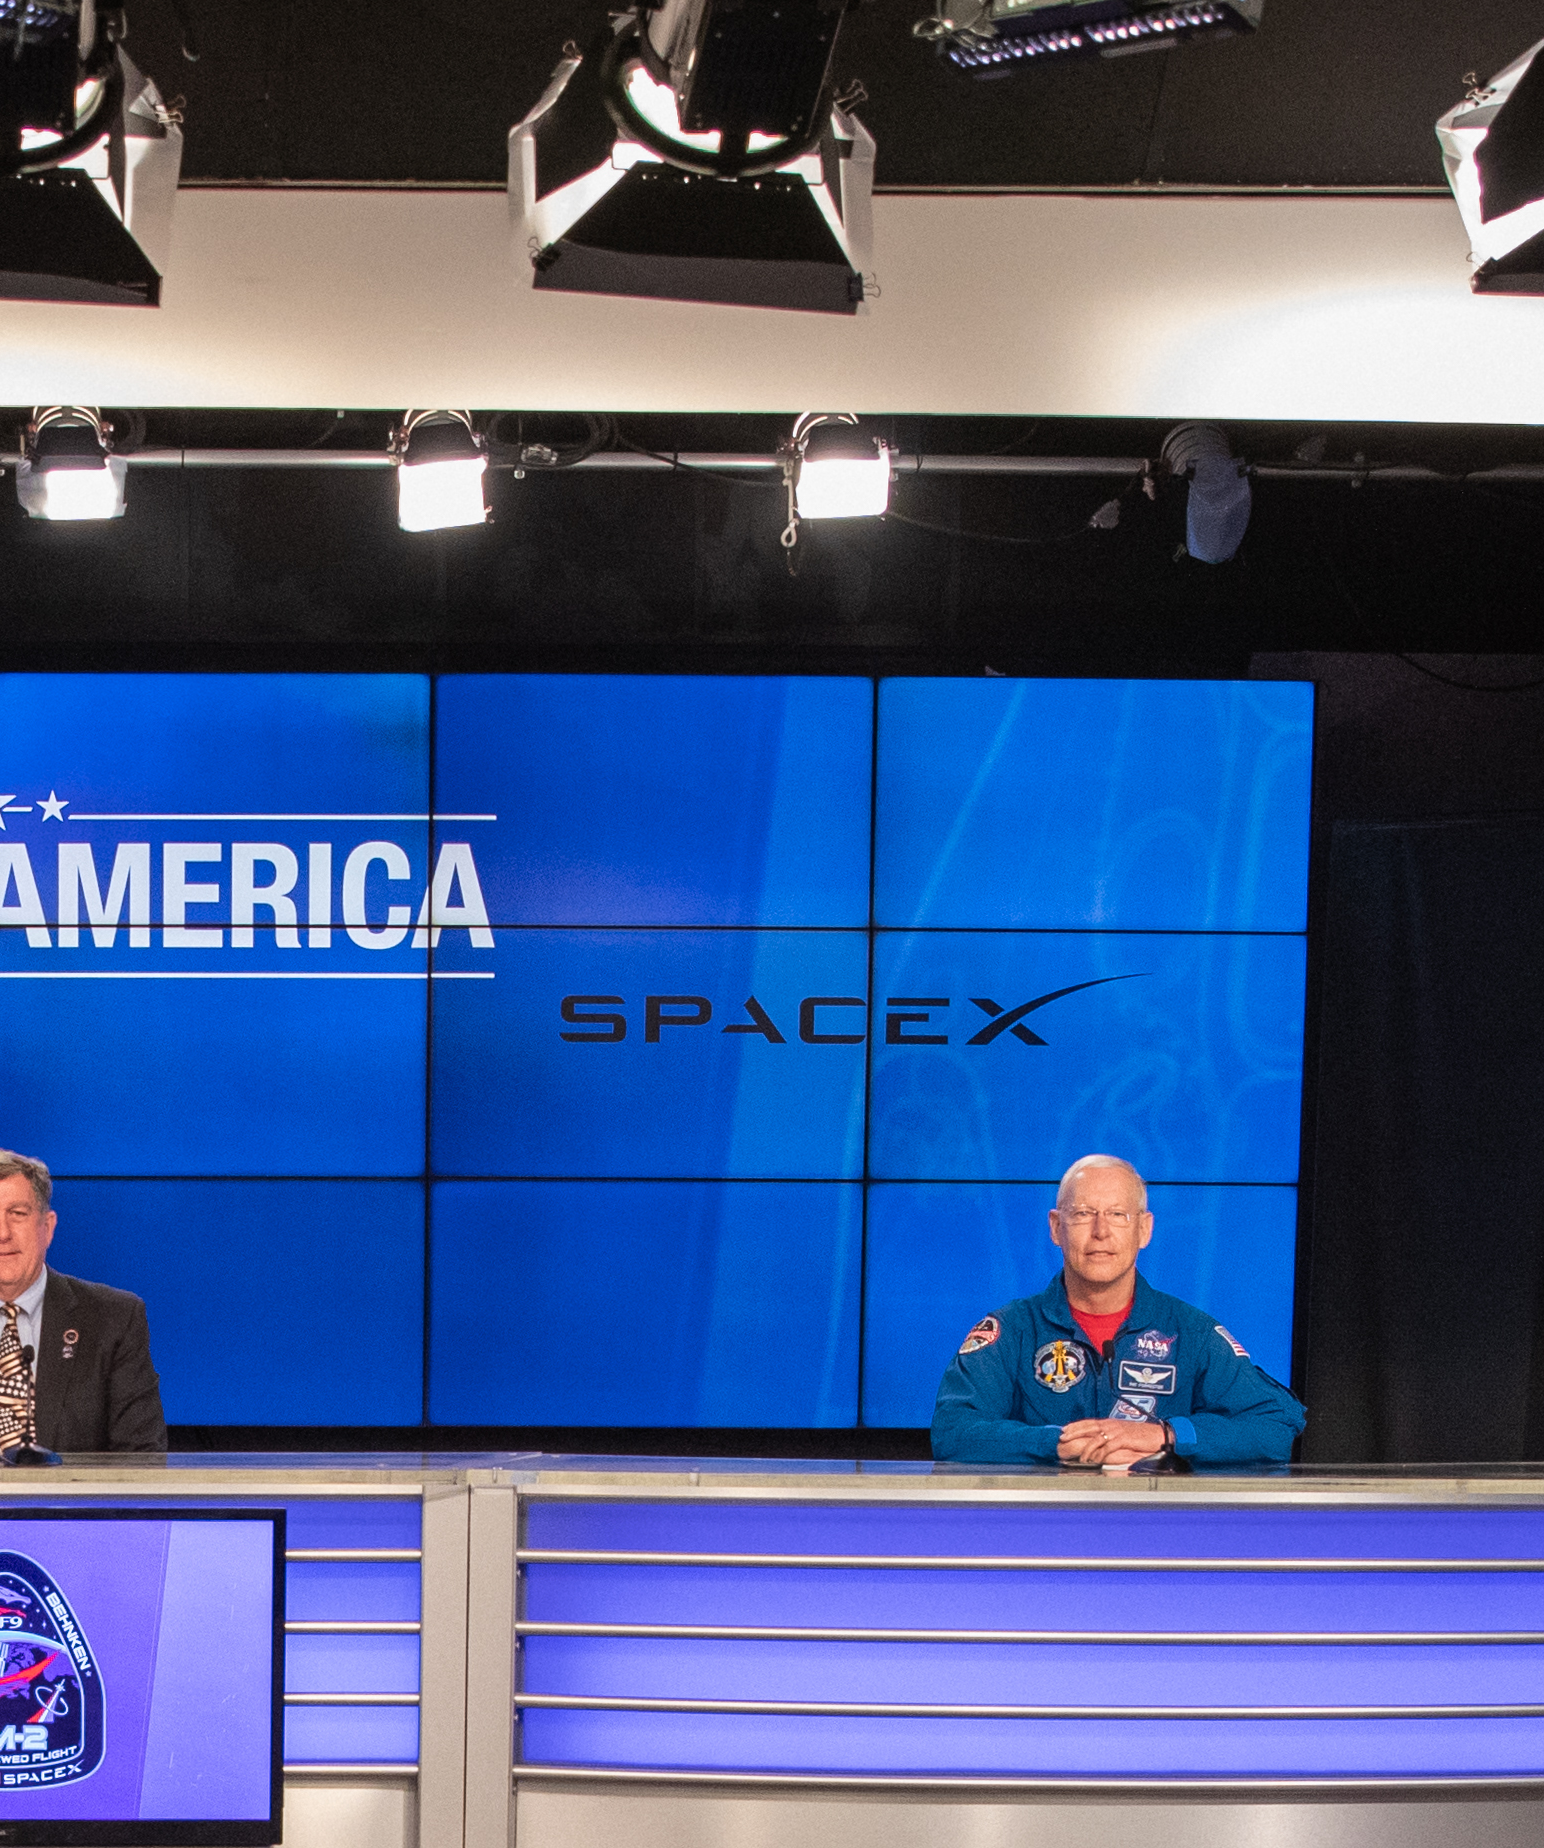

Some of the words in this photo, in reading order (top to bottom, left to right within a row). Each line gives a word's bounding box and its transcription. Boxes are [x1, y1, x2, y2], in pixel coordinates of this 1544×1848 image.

[559, 973, 1153, 1046] SPACEX
[1138, 1338, 1169, 1352] NASA
[0, 1616, 23, 1629] F9
[45, 1591, 92, 1670] BEHNKEN
[32, 1745, 78, 1763] FLIGHT
[4, 1759, 84, 1785] SPACEX
